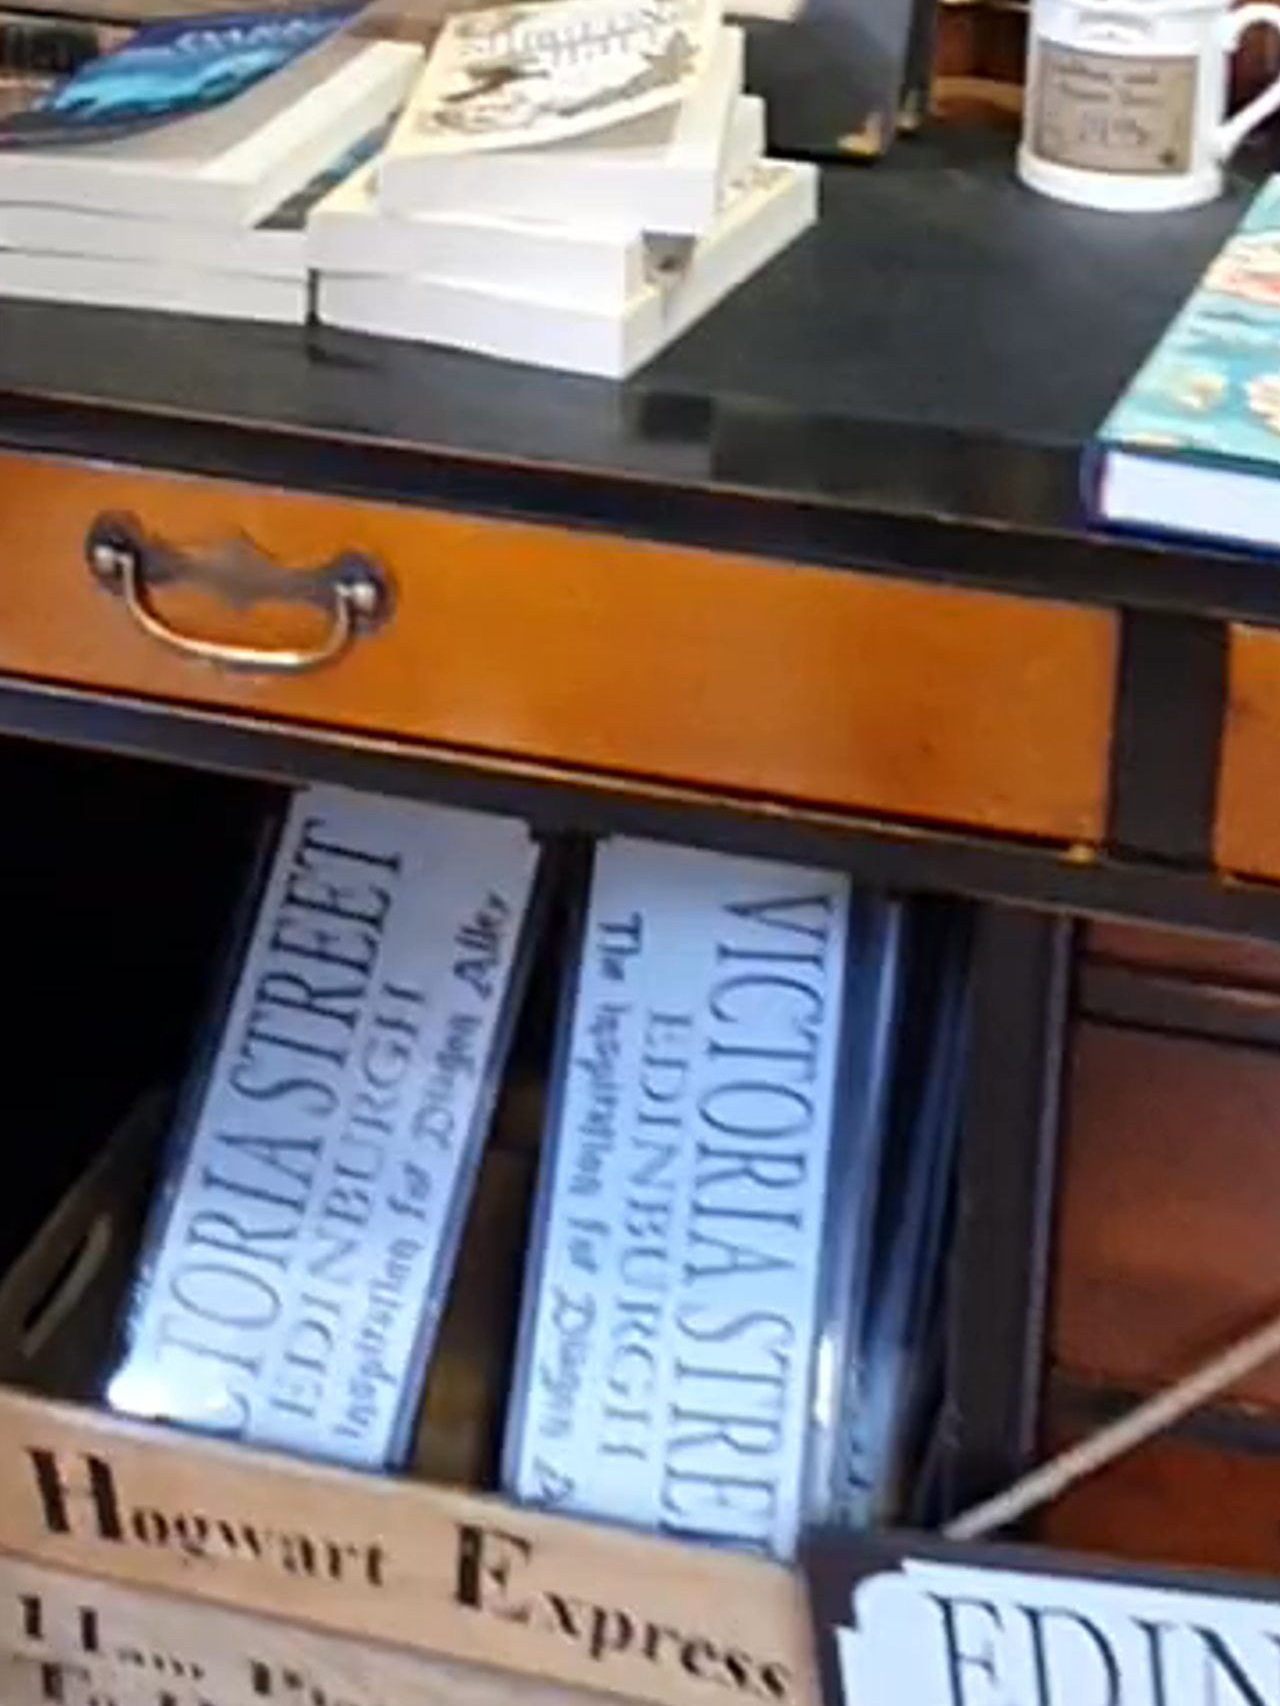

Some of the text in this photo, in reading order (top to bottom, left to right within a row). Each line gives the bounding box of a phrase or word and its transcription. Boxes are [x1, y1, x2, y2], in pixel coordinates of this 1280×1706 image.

[157, 817, 404, 1438] TORIA STREET
[450, 891, 513, 999] Alley
[598, 912, 644, 984] The
[265, 978, 426, 1421] EDINBURGH
[599, 1010, 694, 1462] EDINBURGH
[656, 894, 835, 1556] VICTORIA STRE
[23, 1444, 796, 1700] Hogwart Express
